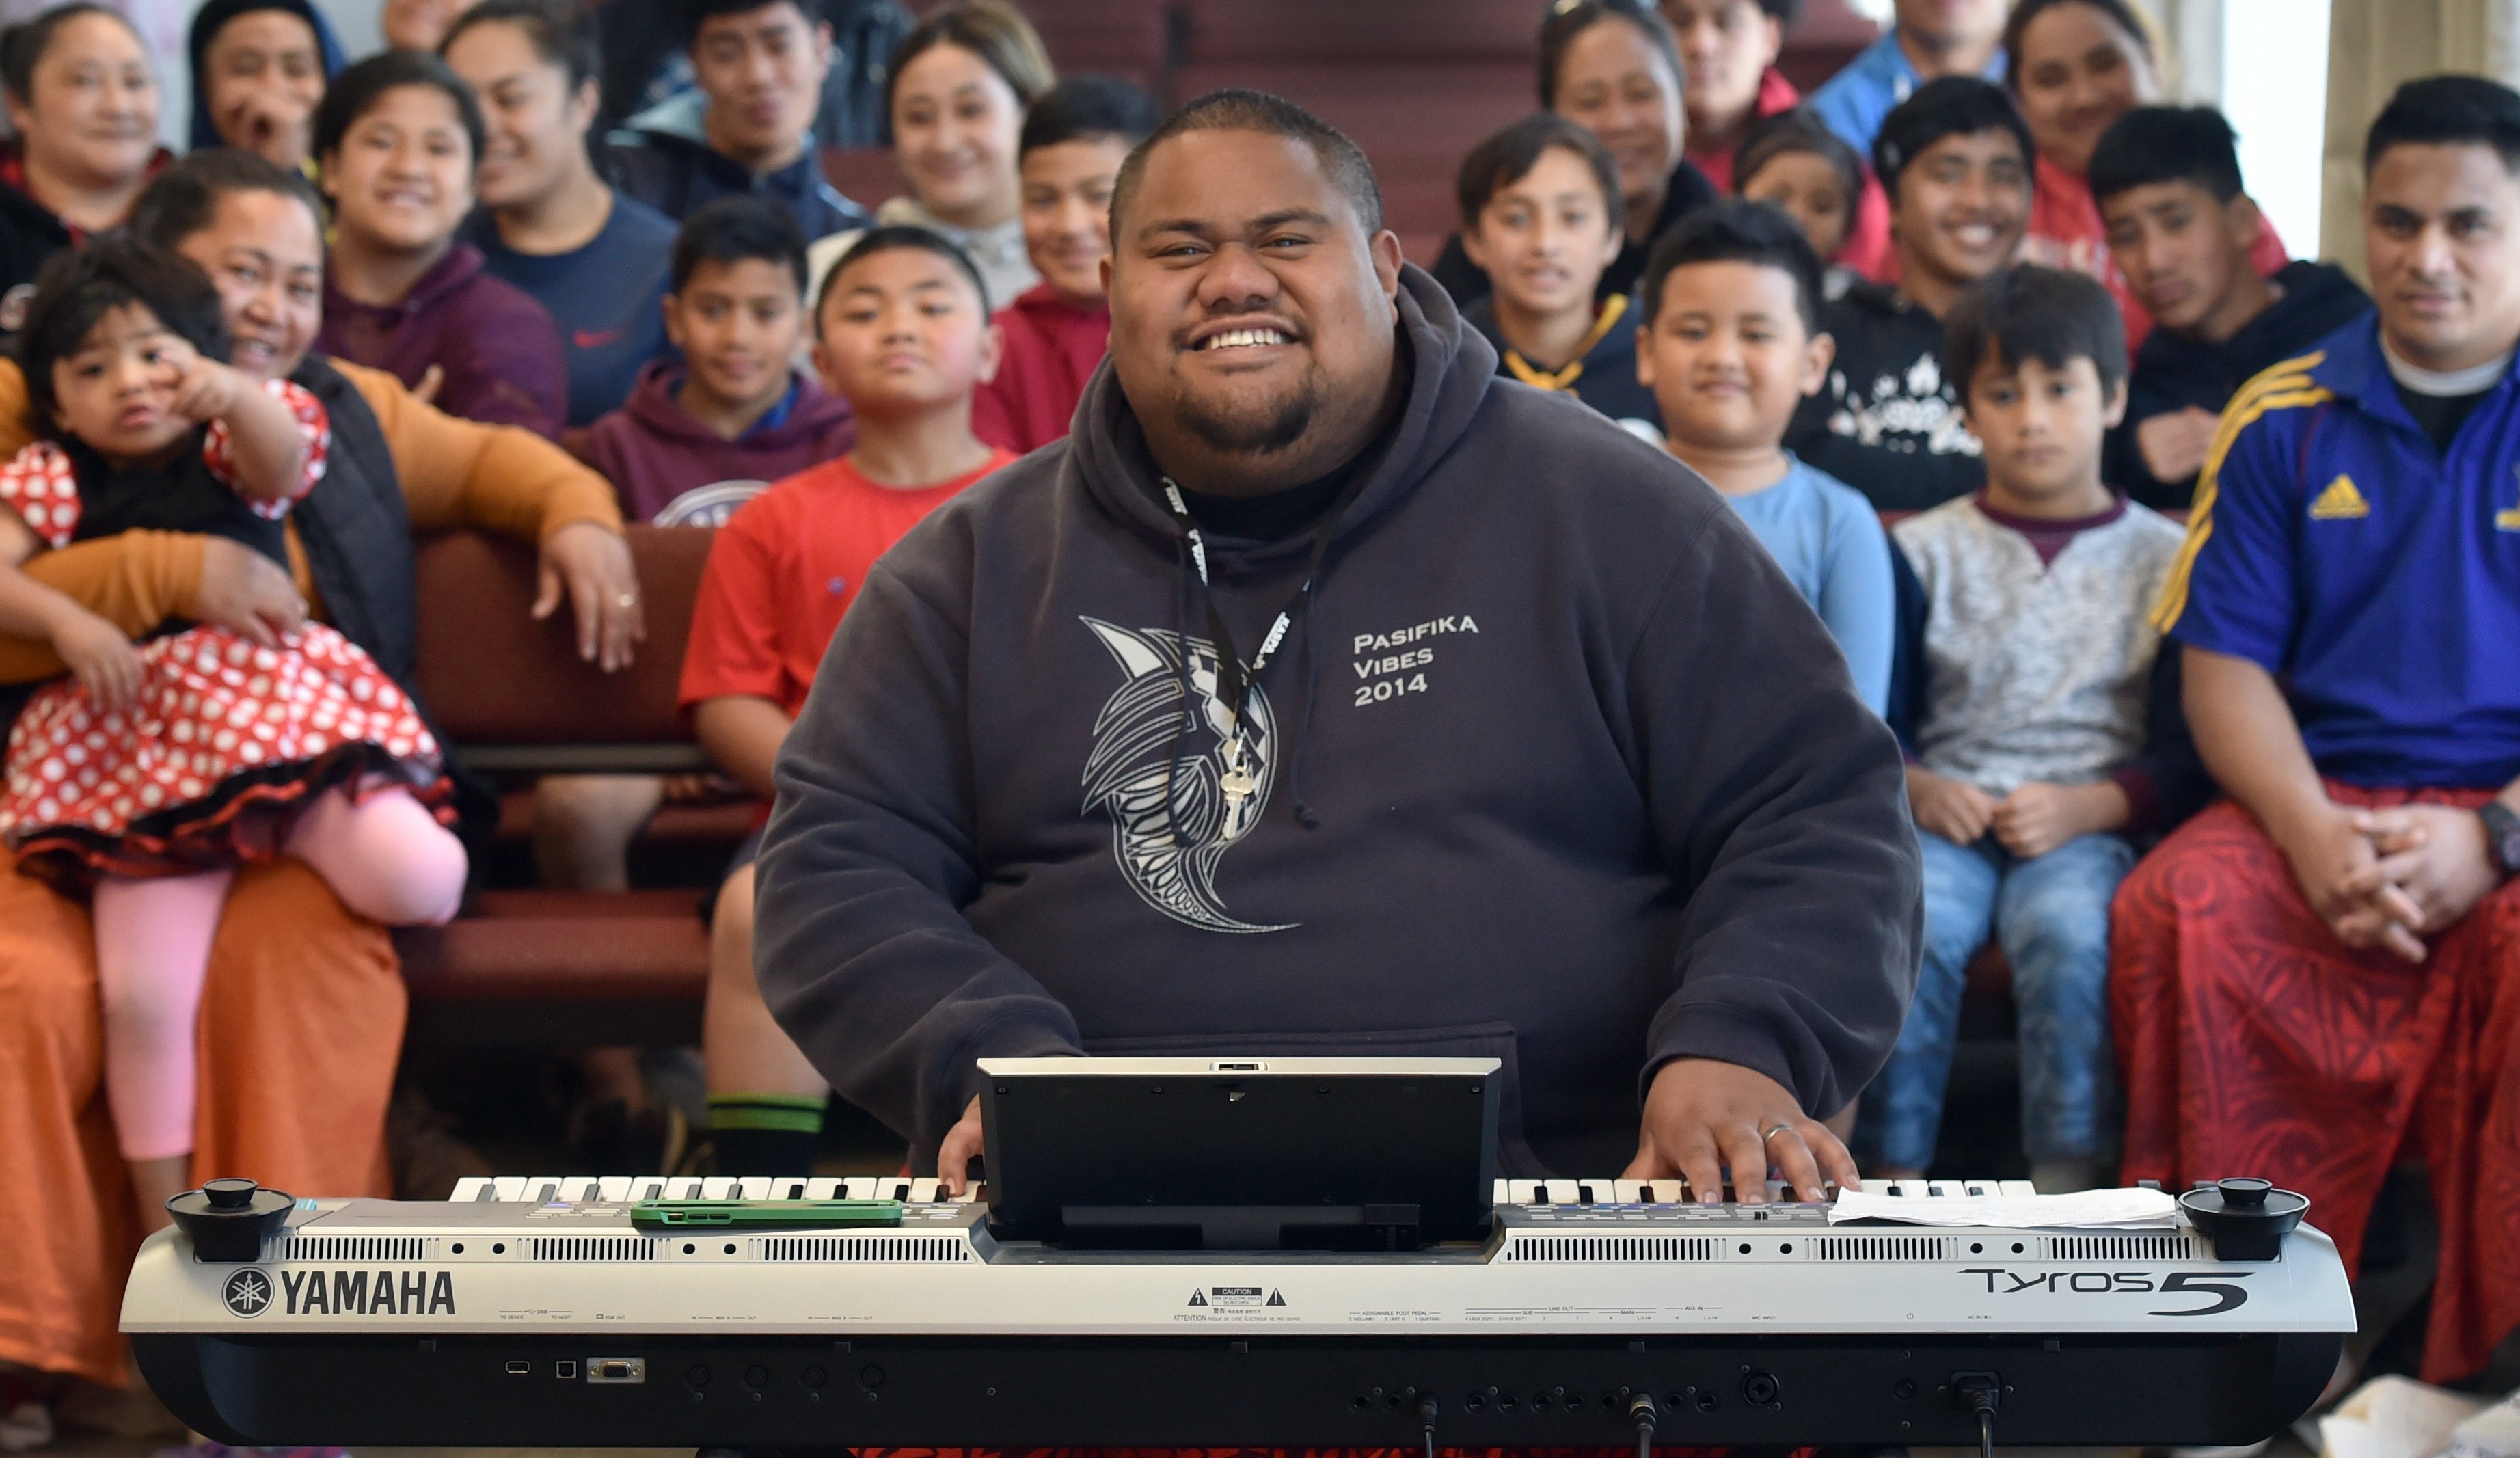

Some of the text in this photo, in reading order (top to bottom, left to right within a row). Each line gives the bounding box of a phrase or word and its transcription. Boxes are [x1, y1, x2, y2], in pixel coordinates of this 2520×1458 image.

[1353, 615, 1480, 655] PASIFIKA
[1353, 647, 1434, 679] VIBES
[1354, 673, 1428, 707] 2014
[281, 1271, 455, 1314] YAMAHA
